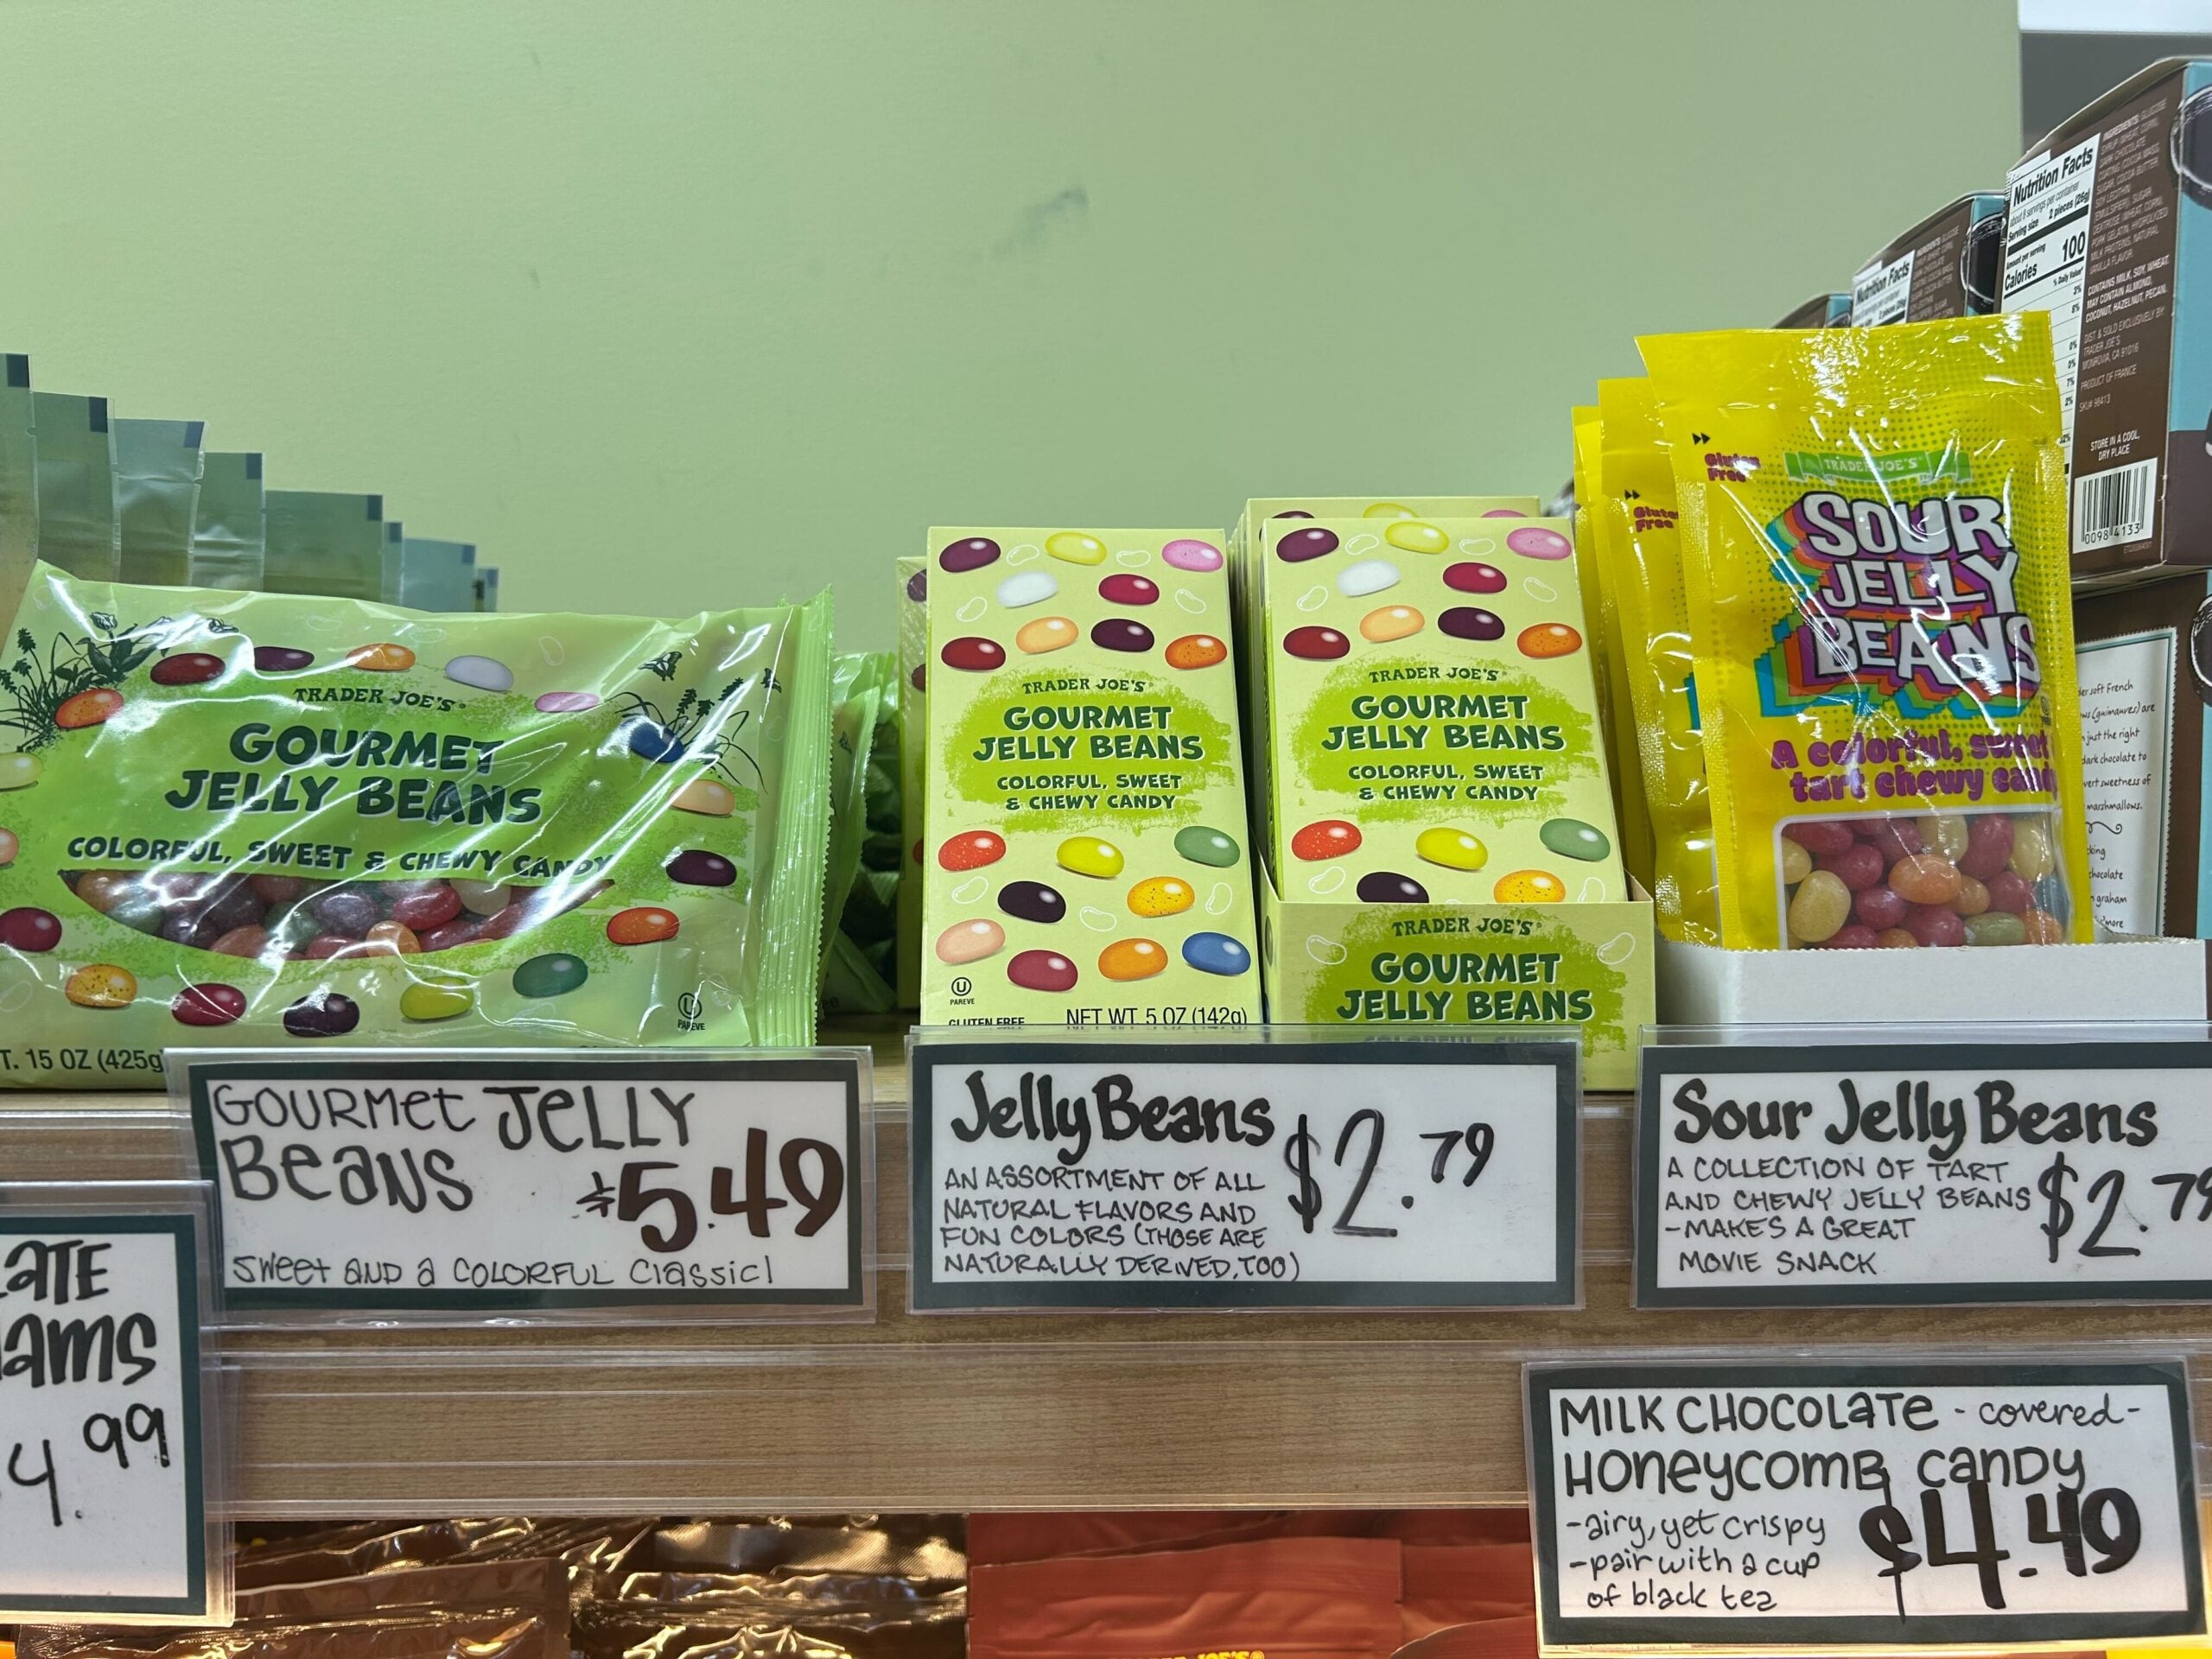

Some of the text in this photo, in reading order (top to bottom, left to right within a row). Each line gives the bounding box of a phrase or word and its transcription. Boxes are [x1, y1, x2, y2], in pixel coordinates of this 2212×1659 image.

[2013, 148, 2093, 207] Nutrition Facts
[2062, 231, 2085, 262] 100
[2005, 263, 2037, 290] Calories
[2080, 364, 2137, 391] PRODUCT OF FRANCE
[2090, 436, 2108, 452] STORE
[2109, 435, 2116, 446] IN
[2116, 434, 2121, 444] A
[2098, 443, 2130, 461] DRY PLACE
[1707, 467, 1746, 482] Free
[1636, 518, 1674, 532] Free
[1800, 491, 2013, 557] SOUR
[2084, 523, 2140, 544] 0098 4133
[1821, 550, 2018, 618] JELLY
[1815, 611, 2042, 687] BEANS
[1021, 678, 1148, 695] TRADER JOE'S
[1368, 667, 1499, 683] TRADER JOE'S
[2089, 679, 2133, 696] soft French
[292, 688, 456, 711] TRADER JOE'S
[1351, 695, 1529, 720] GOURMET
[2141, 703, 2156, 713] are
[1003, 705, 1172, 731] GOURMET
[229, 722, 504, 774] GOURMET
[973, 735, 1205, 761] JELLY BEANS
[1321, 724, 1565, 751] JELLY BEANS
[1770, 728, 2050, 769] A colorful, sweet
[2086, 727, 2139, 746] just the right
[2101, 751, 2136, 764] chocolate
[2139, 751, 2147, 761] to
[996, 774, 1183, 791] COLORFUL, SWEET
[1348, 764, 1543, 781] COLORFUL, SWEET
[1789, 766, 1866, 803] tart
[1874, 766, 1985, 801] chewy
[2100, 773, 2152, 787] sweetness of
[164, 771, 543, 825] JELLY BEANS
[1005, 794, 1176, 810] & CHEWY CANDY
[1358, 785, 1538, 801] & CHEWY CANDY
[2087, 798, 2143, 810] marshmallows.
[67, 836, 232, 864] COLORFUL,
[248, 842, 353, 870] SWEET
[364, 850, 386, 872] &
[399, 849, 503, 873] CHEWY
[2088, 868, 2124, 880] chocolate
[2096, 892, 2127, 907] graham
[1391, 918, 1534, 937] TRADER JOE'S
[1370, 952, 1560, 984] GOURMET
[1146, 1008, 1157, 1024] 5
[1336, 989, 1593, 1020] JELLY BEANS
[25, 1049, 53, 1070] 15
[60, 1049, 92, 1070] OZ
[97, 1049, 164, 1073] (425g
[950, 1070, 1275, 1166] Jelly Beans
[1672, 1077, 2158, 1161] Sour Jelly Beans
[944, 1164, 1265, 1192] AN ASSORTMENT OF ALL
[1283, 1108, 1495, 1238] $2.79
[1668, 1155, 2008, 1183] A COLLECTION OF TART
[576, 1127, 844, 1253] $5.49
[1665, 1185, 2031, 1211] AND CHEWY JELLY BEANS
[944, 1197, 1255, 1225] NATURAL FLAVORS AND
[2037, 1151, 2212, 1263] $2.79
[940, 1223, 1268, 1249] FUN COLORS (THOSE ARE
[1795, 1216, 1815, 1237] A
[1822, 1216, 1916, 1240] GREAT
[454, 1257, 614, 1287] COLORFUL
[944, 1253, 1109, 1276] NATURALLY
[1679, 1250, 1878, 1275] MOVIE SNACK
[0, 1312, 156, 1388] ams
[1560, 1395, 1665, 1436] MILK
[0, 1402, 171, 1528] 4.99
[1662, 1510, 1719, 1549] yet
[1723, 1516, 1826, 1546] crispy
[1859, 1467, 2141, 1624] $4.49
[1658, 1546, 1732, 1574] with
[1742, 1552, 1758, 1576] a
[1765, 1551, 1821, 1578] cup
[1587, 1579, 1777, 1611] of black tea
